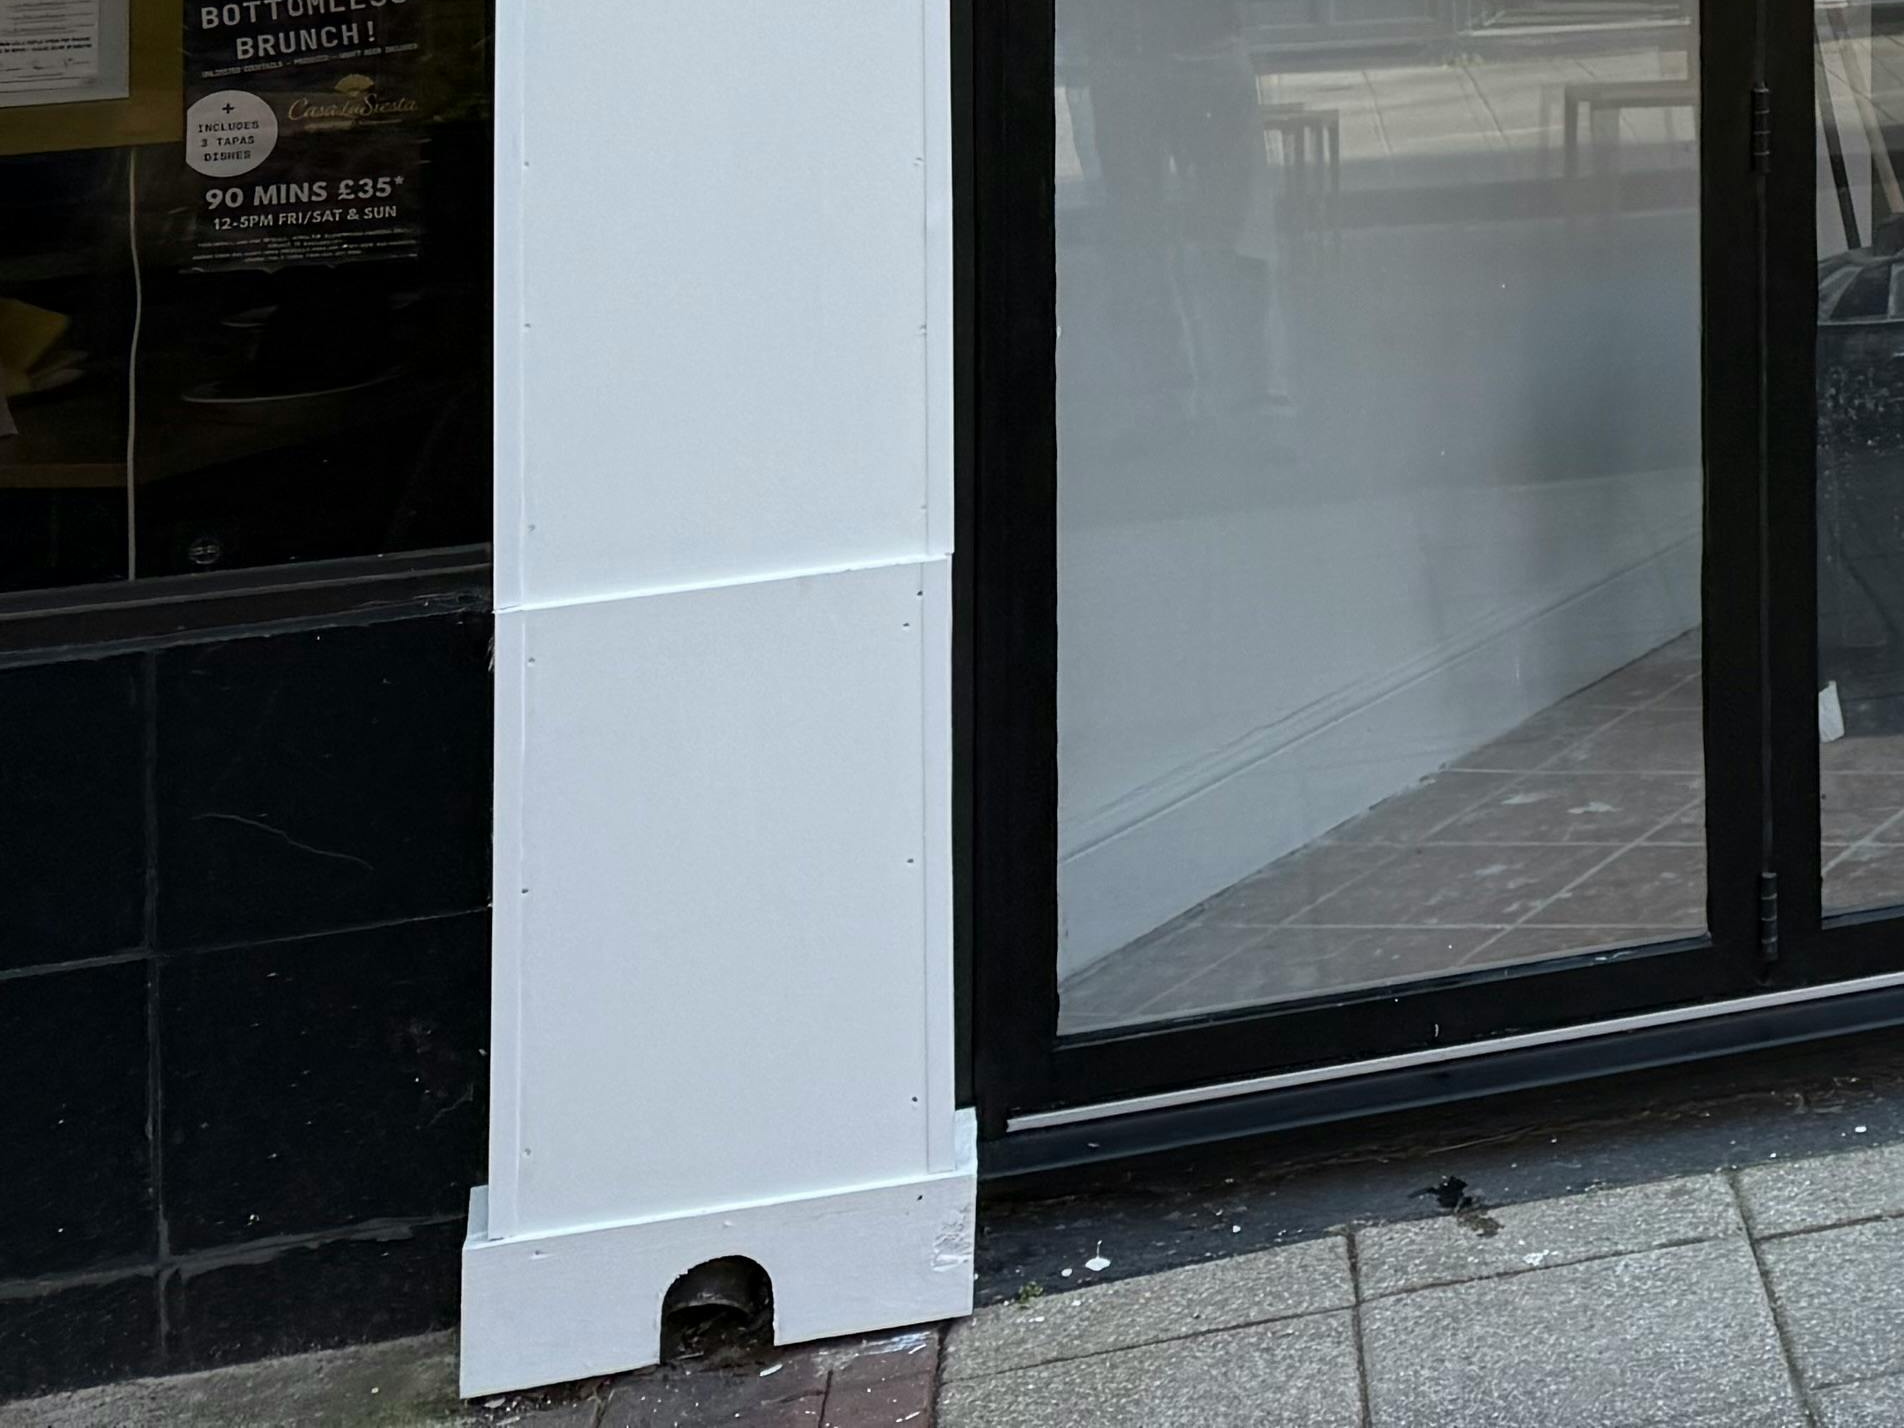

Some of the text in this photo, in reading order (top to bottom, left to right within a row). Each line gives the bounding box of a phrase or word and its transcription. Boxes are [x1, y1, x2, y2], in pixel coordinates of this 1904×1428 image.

[236, 20, 376, 61] BRUNCH!
[198, 120, 260, 133] INCLUDES
[217, 136, 255, 146] TAPAS
[204, 150, 251, 162] DISHES
[204, 187, 245, 210] 90
[253, 180, 328, 207] MINS
[214, 204, 397, 231] 12-5PM FRI/SAT & SUN
